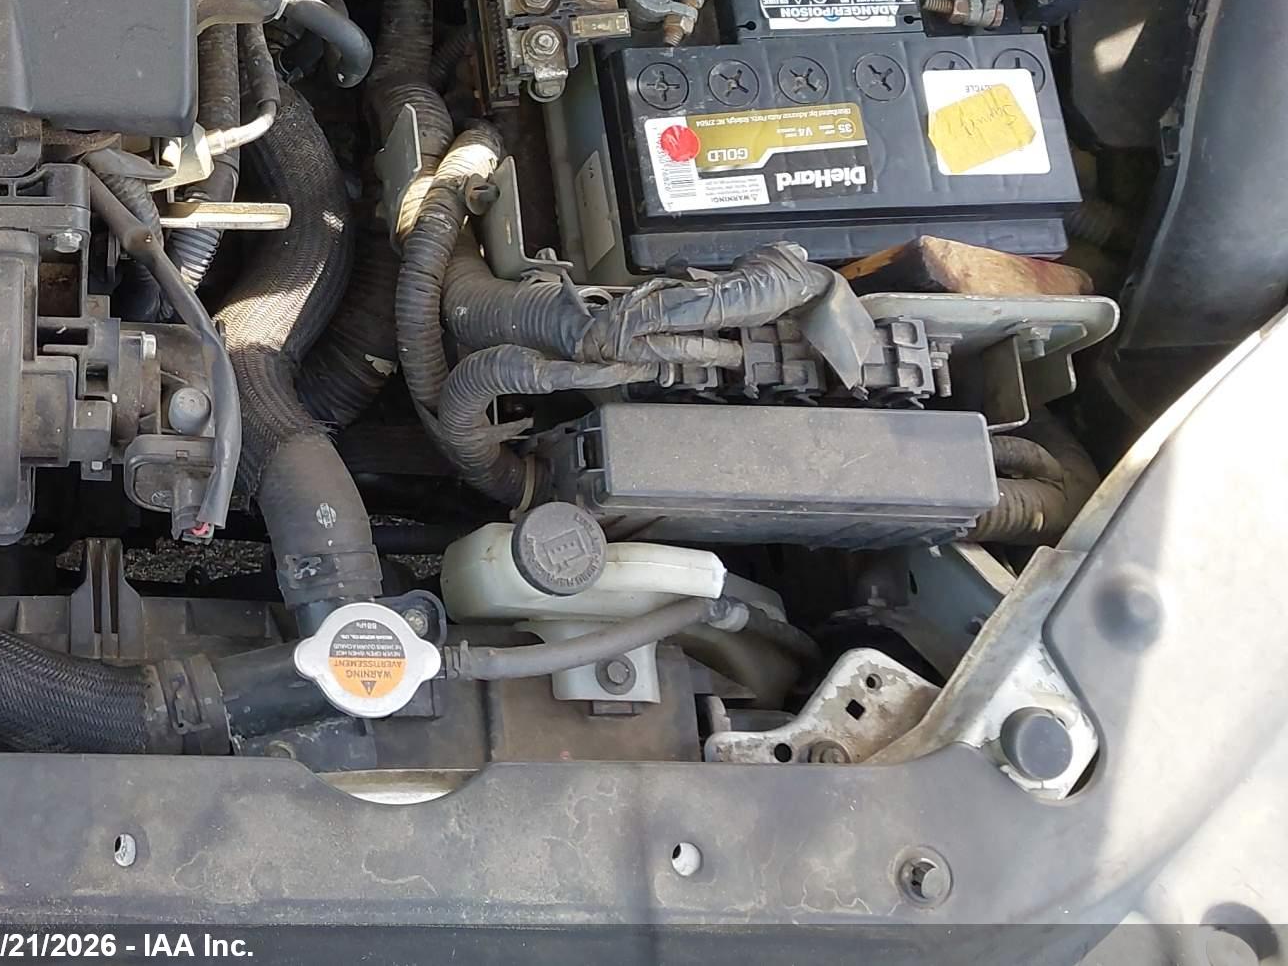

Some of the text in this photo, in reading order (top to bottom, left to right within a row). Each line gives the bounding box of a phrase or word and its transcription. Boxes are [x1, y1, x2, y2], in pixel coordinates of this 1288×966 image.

[780, 5, 890, 18] DANGER/POISON
[838, 123, 852, 133] 35
[707, 147, 748, 162] GOLD
[776, 166, 866, 191] DieHard
[334, 659, 402, 668] AVERTISSEMENT
[345, 669, 392, 679] WARNING
